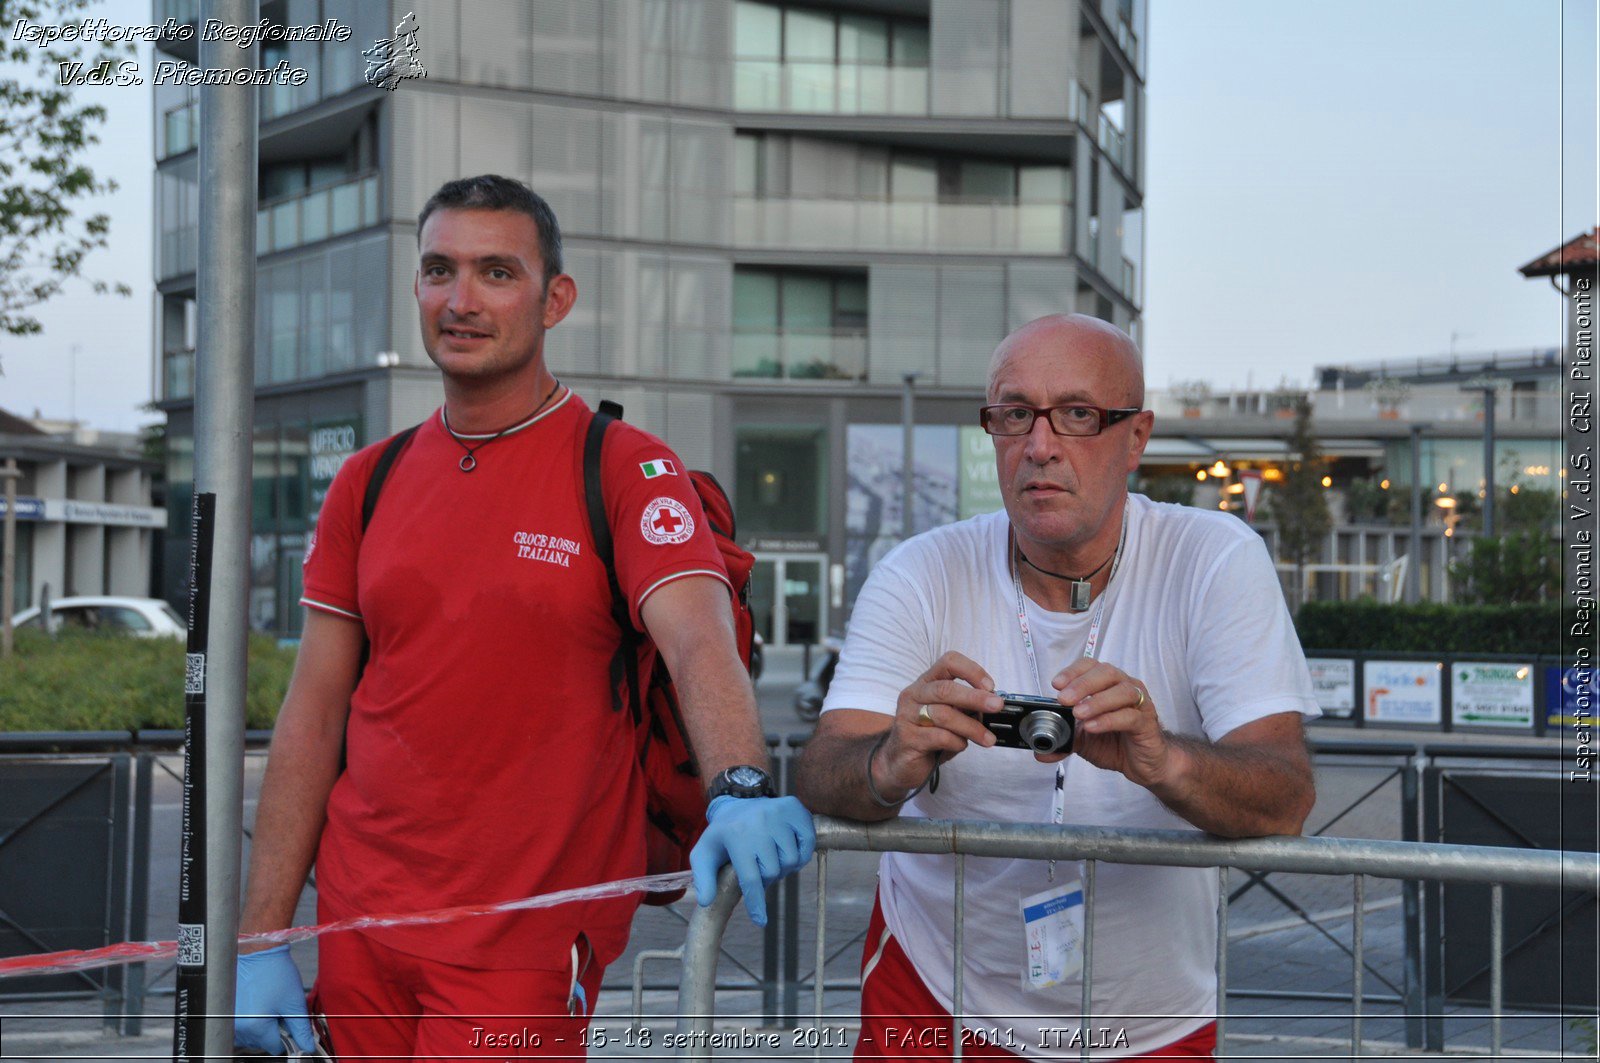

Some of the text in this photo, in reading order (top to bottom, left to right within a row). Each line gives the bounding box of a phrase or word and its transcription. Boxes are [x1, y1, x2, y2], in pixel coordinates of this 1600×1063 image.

[513, 531, 581, 556] CROCE ROSSA
[518, 545, 570, 567] ITALIANA
